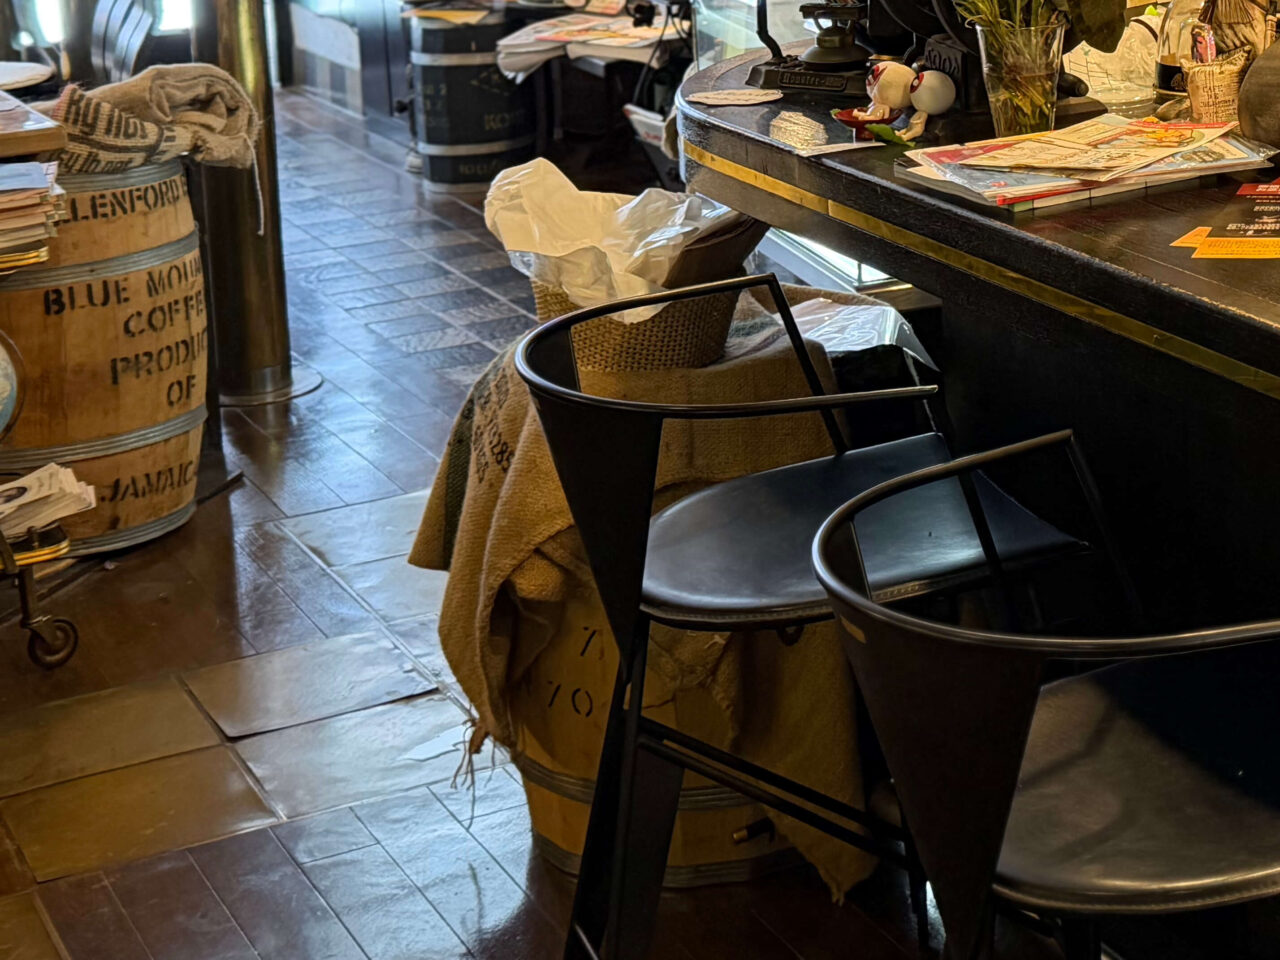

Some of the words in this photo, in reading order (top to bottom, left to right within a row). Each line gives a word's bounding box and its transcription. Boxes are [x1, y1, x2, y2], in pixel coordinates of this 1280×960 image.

[54, 176, 181, 227] LENFORD
[44, 279, 130, 316] BLUE
[167, 374, 196, 407] OF
